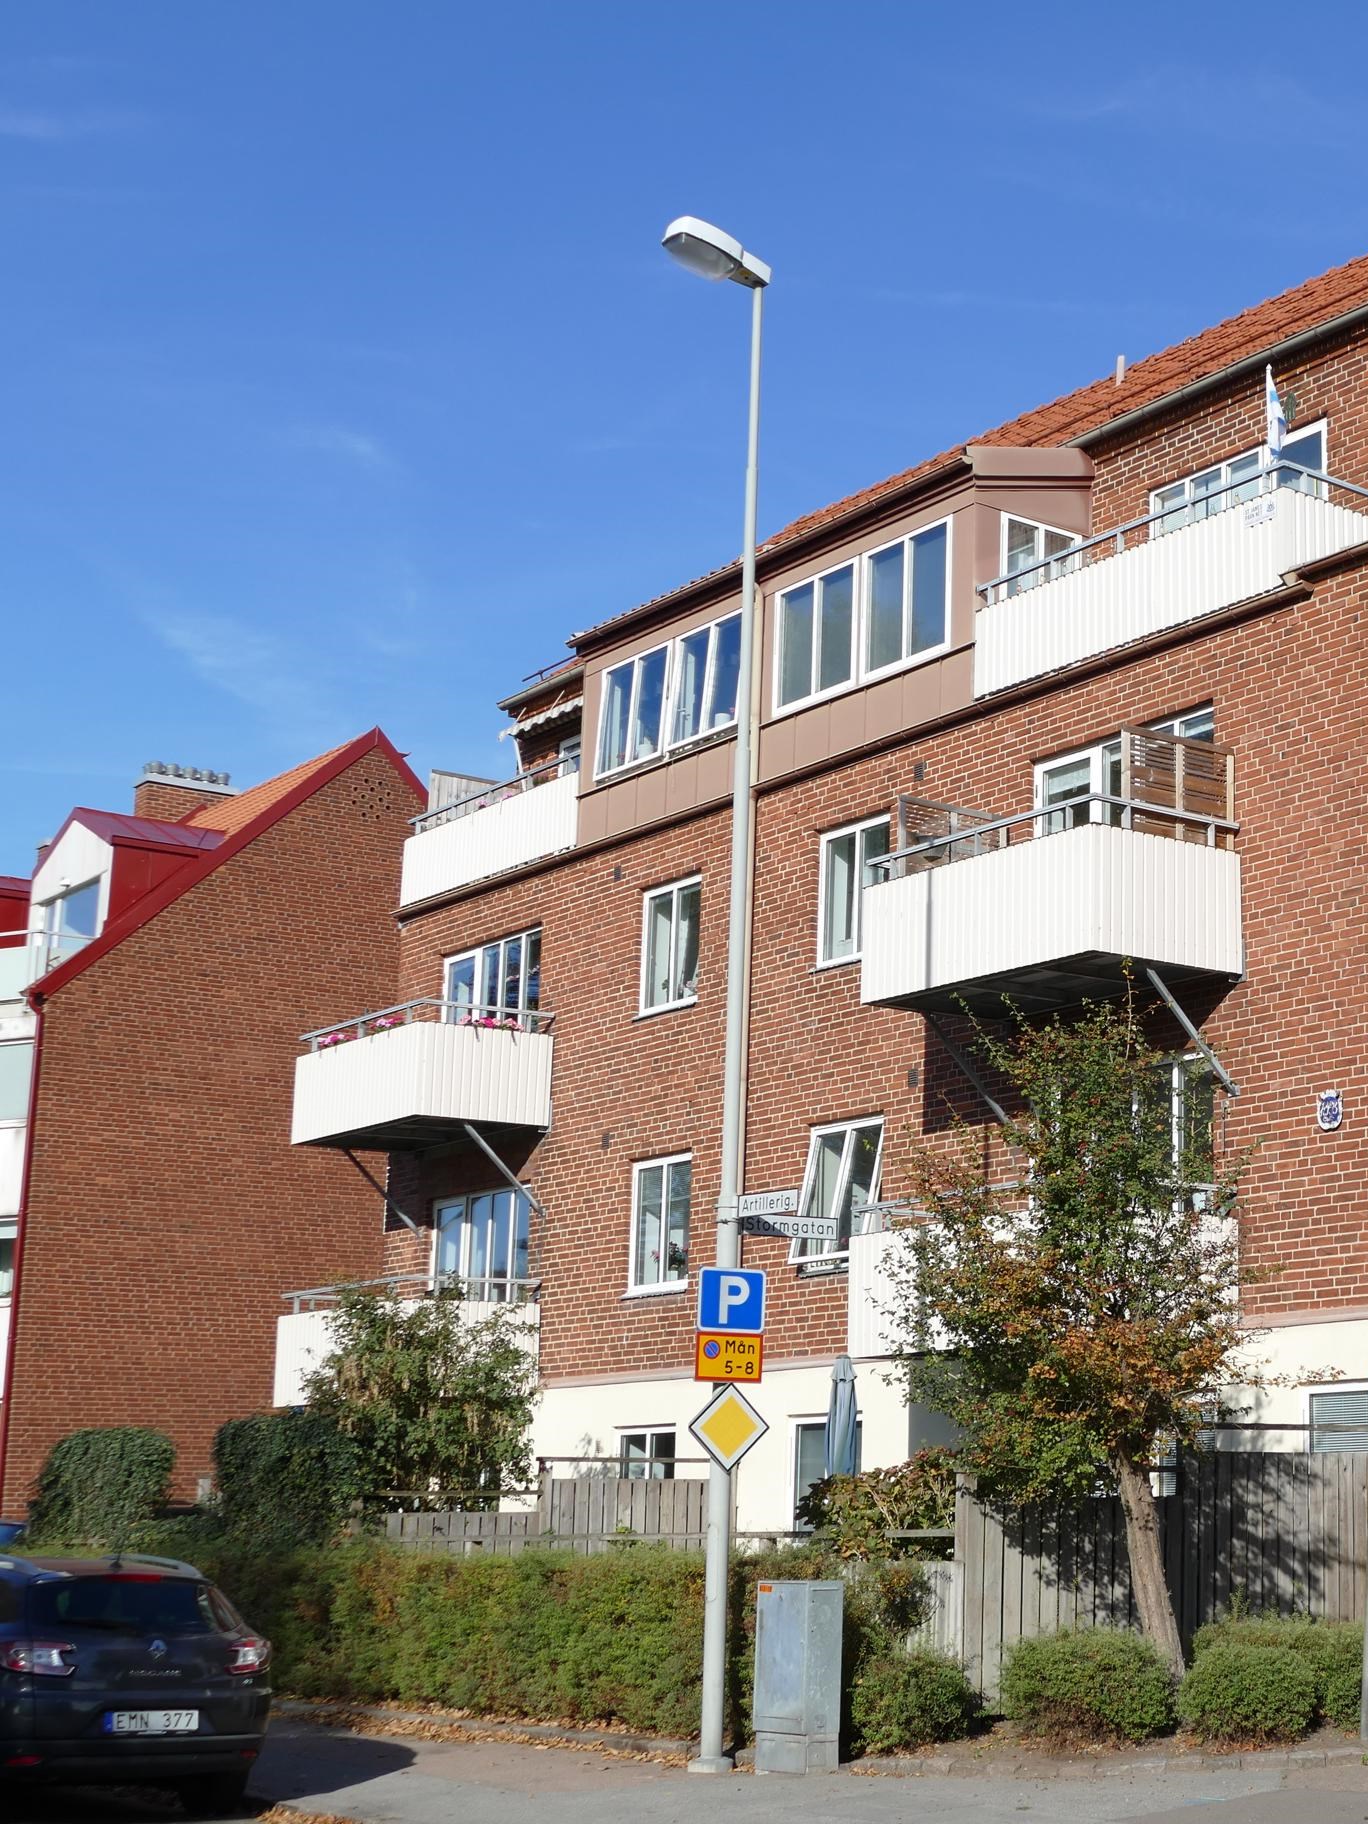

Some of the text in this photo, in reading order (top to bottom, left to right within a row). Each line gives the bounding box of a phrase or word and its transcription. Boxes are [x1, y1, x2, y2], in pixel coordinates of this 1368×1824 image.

[741, 1195, 794, 1212] Artillerig.
[746, 1217, 834, 1236] Stormgatan
[718, 1275, 750, 1325] P
[725, 1340, 755, 1355] Mån
[724, 1360, 754, 1375] 5-8
[116, 1712, 193, 1729] EMN 377
